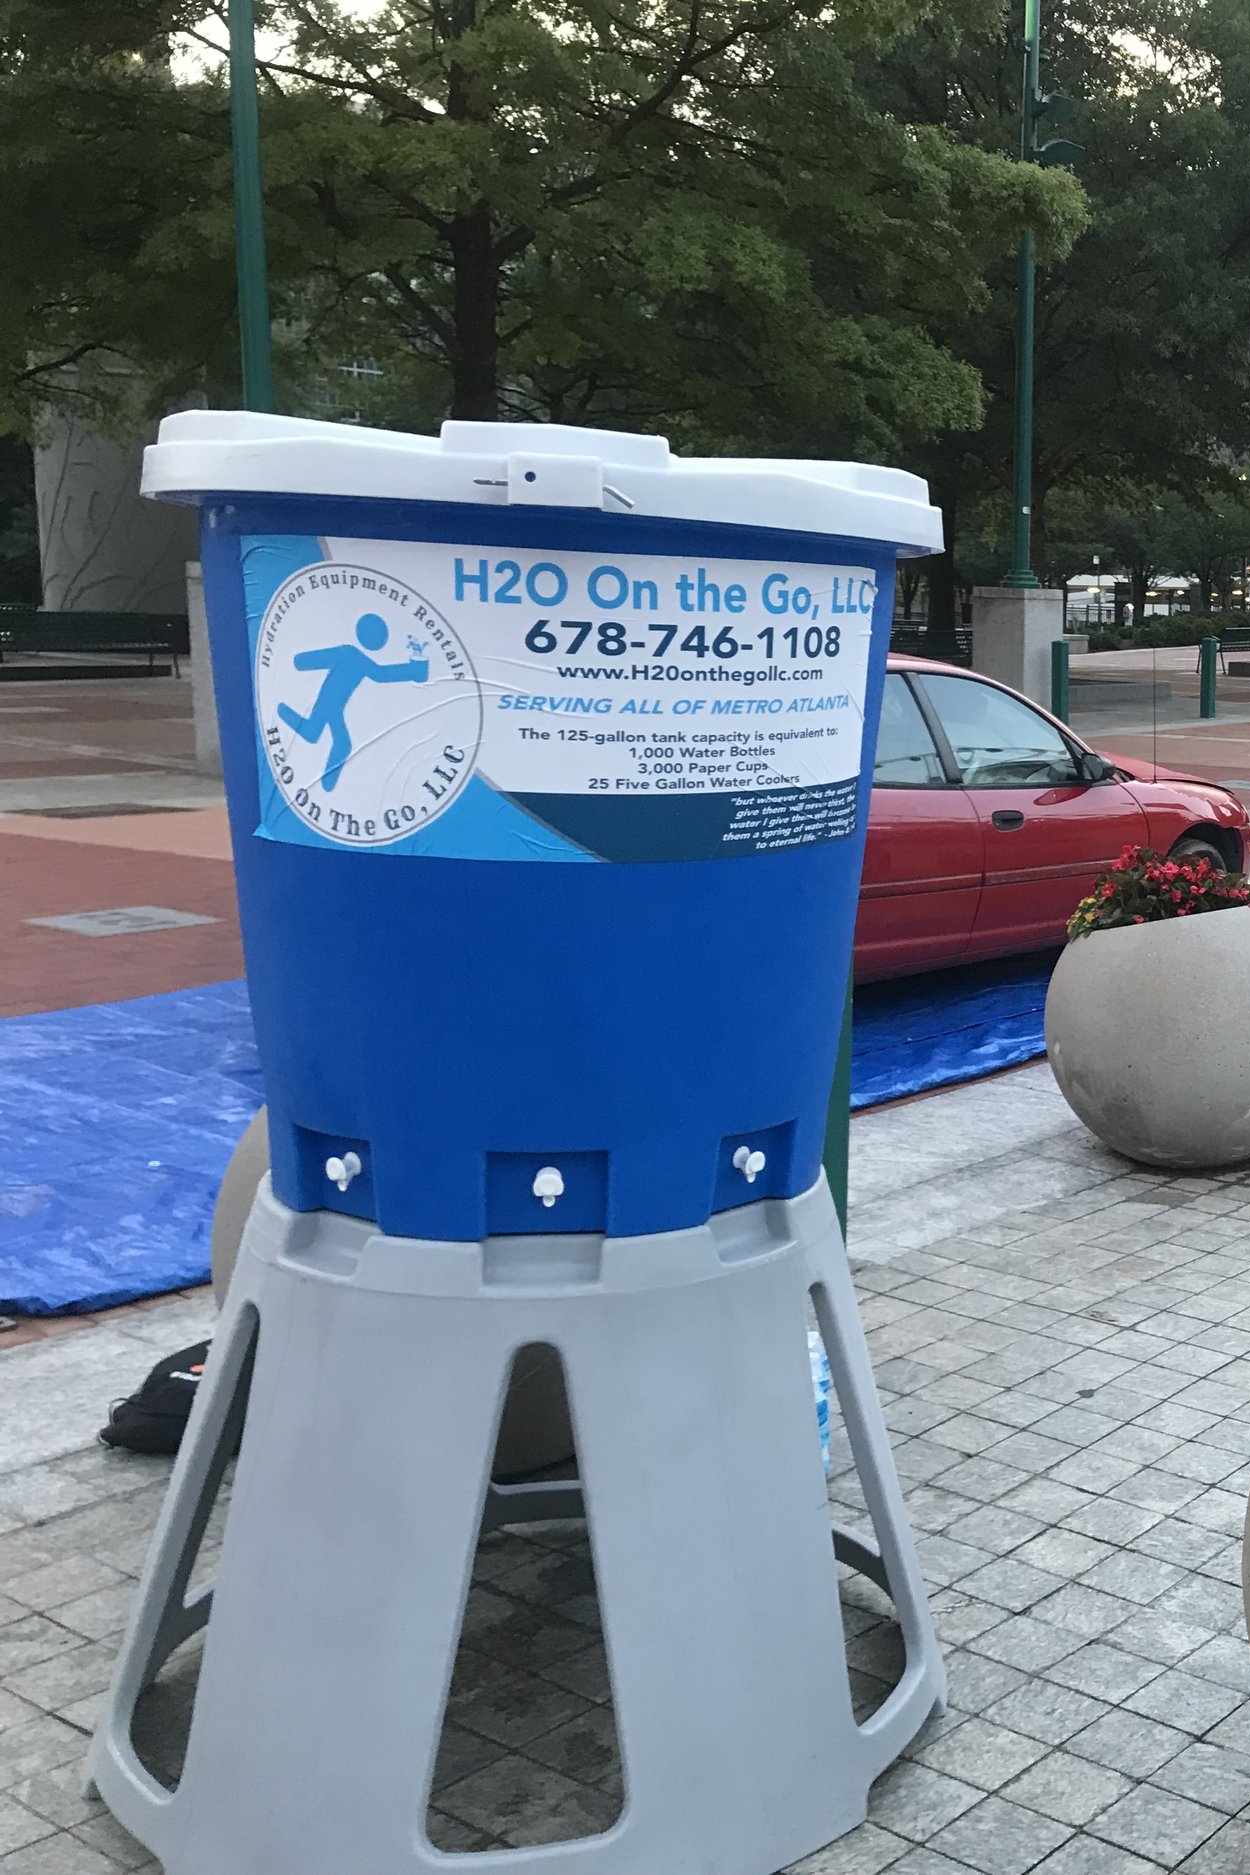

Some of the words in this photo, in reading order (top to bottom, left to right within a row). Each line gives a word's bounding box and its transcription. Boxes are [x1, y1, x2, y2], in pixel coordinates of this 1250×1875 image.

[454, 558, 568, 607] H2O
[587, 565, 658, 610] On
[675, 567, 747, 613] the
[762, 573, 819, 620] Go,
[831, 576, 873, 614] LLC
[261, 584, 305, 668] Hydration
[308, 570, 408, 607] Equipment
[413, 605, 466, 681] Rentals
[525, 619, 841, 660] 678-746-1108
[498, 694, 613, 713] SERVING
[619, 699, 664, 715] ALL
[672, 699, 706, 715] OF
[710, 698, 783, 715] METRO
[787, 694, 849, 713] ATLANTA
[518, 727, 551, 741] The
[557, 729, 646, 745] 125-gallon
[652, 731, 686, 743] tank
[691, 731, 750, 745] capacity
[754, 730, 764, 741] is
[768, 727, 824, 743] equivalent
[826, 726, 839, 737] to:
[629, 747, 674, 760] 1,000
[680, 747, 726, 758] Water
[730, 745, 776, 757] Bottles
[638, 762, 684, 775] 3,000
[689, 762, 731, 776] Paper
[736, 761, 769, 775] Cups
[295, 788, 321, 822] On
[329, 808, 376, 836] The
[422, 744, 465, 800] LLC
[588, 778, 609, 790] 25
[616, 778, 650, 790] Five
[655, 777, 705, 790] Gallon
[710, 777, 752, 789] Water
[756, 774, 800, 786] Coolers
[757, 793, 798, 804] whoever
[824, 789, 836, 797] the
[729, 820, 761, 829] water
[769, 815, 789, 827] give
[814, 810, 828, 820] will
[735, 809, 759, 820] give
[762, 805, 786, 815] them
[789, 802, 804, 812] will
[722, 832, 750, 841] them
[753, 831, 760, 839] a
[761, 826, 791, 839] spring
[792, 823, 803, 833] of
[756, 841, 766, 849] to
[769, 836, 801, 848] eternal
